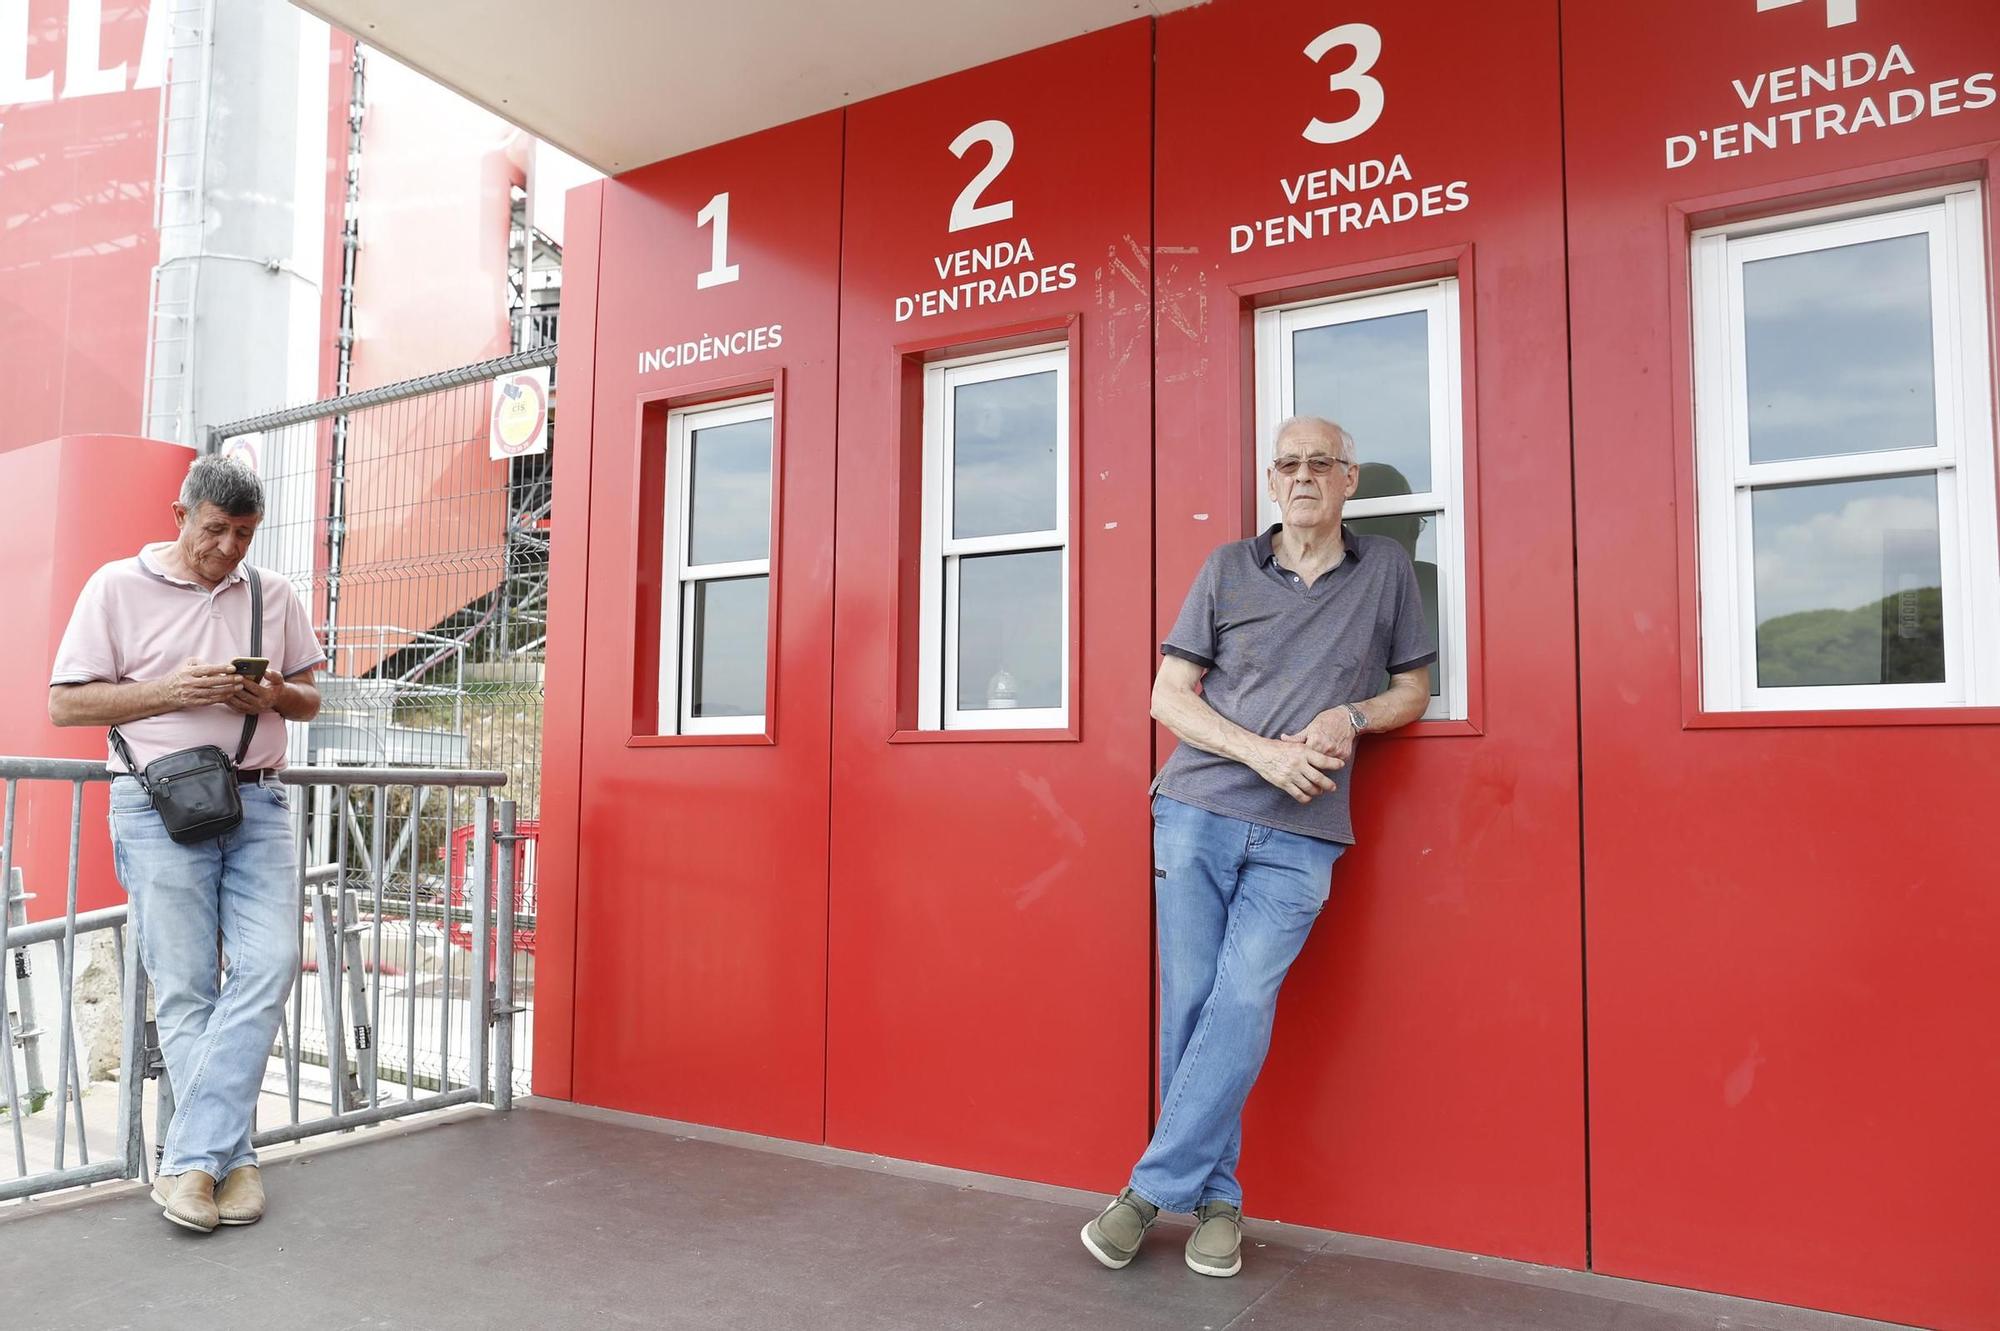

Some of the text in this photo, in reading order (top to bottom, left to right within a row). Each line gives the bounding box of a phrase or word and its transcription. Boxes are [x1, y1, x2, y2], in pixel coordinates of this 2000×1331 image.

[1301, 23, 1385, 144] 3
[1731, 44, 1916, 109] VENDA
[1665, 72, 1997, 170] D'ENTRADES
[948, 119, 1015, 233] 2
[1280, 154, 1413, 204] VENDA
[696, 191, 739, 290] 1
[1230, 180, 1470, 254] D'ENTRADES
[895, 262, 1077, 323] D'ENTRADES
[934, 238, 1035, 280] VENDA
[638, 324, 783, 374] INCIDÈNCIES
